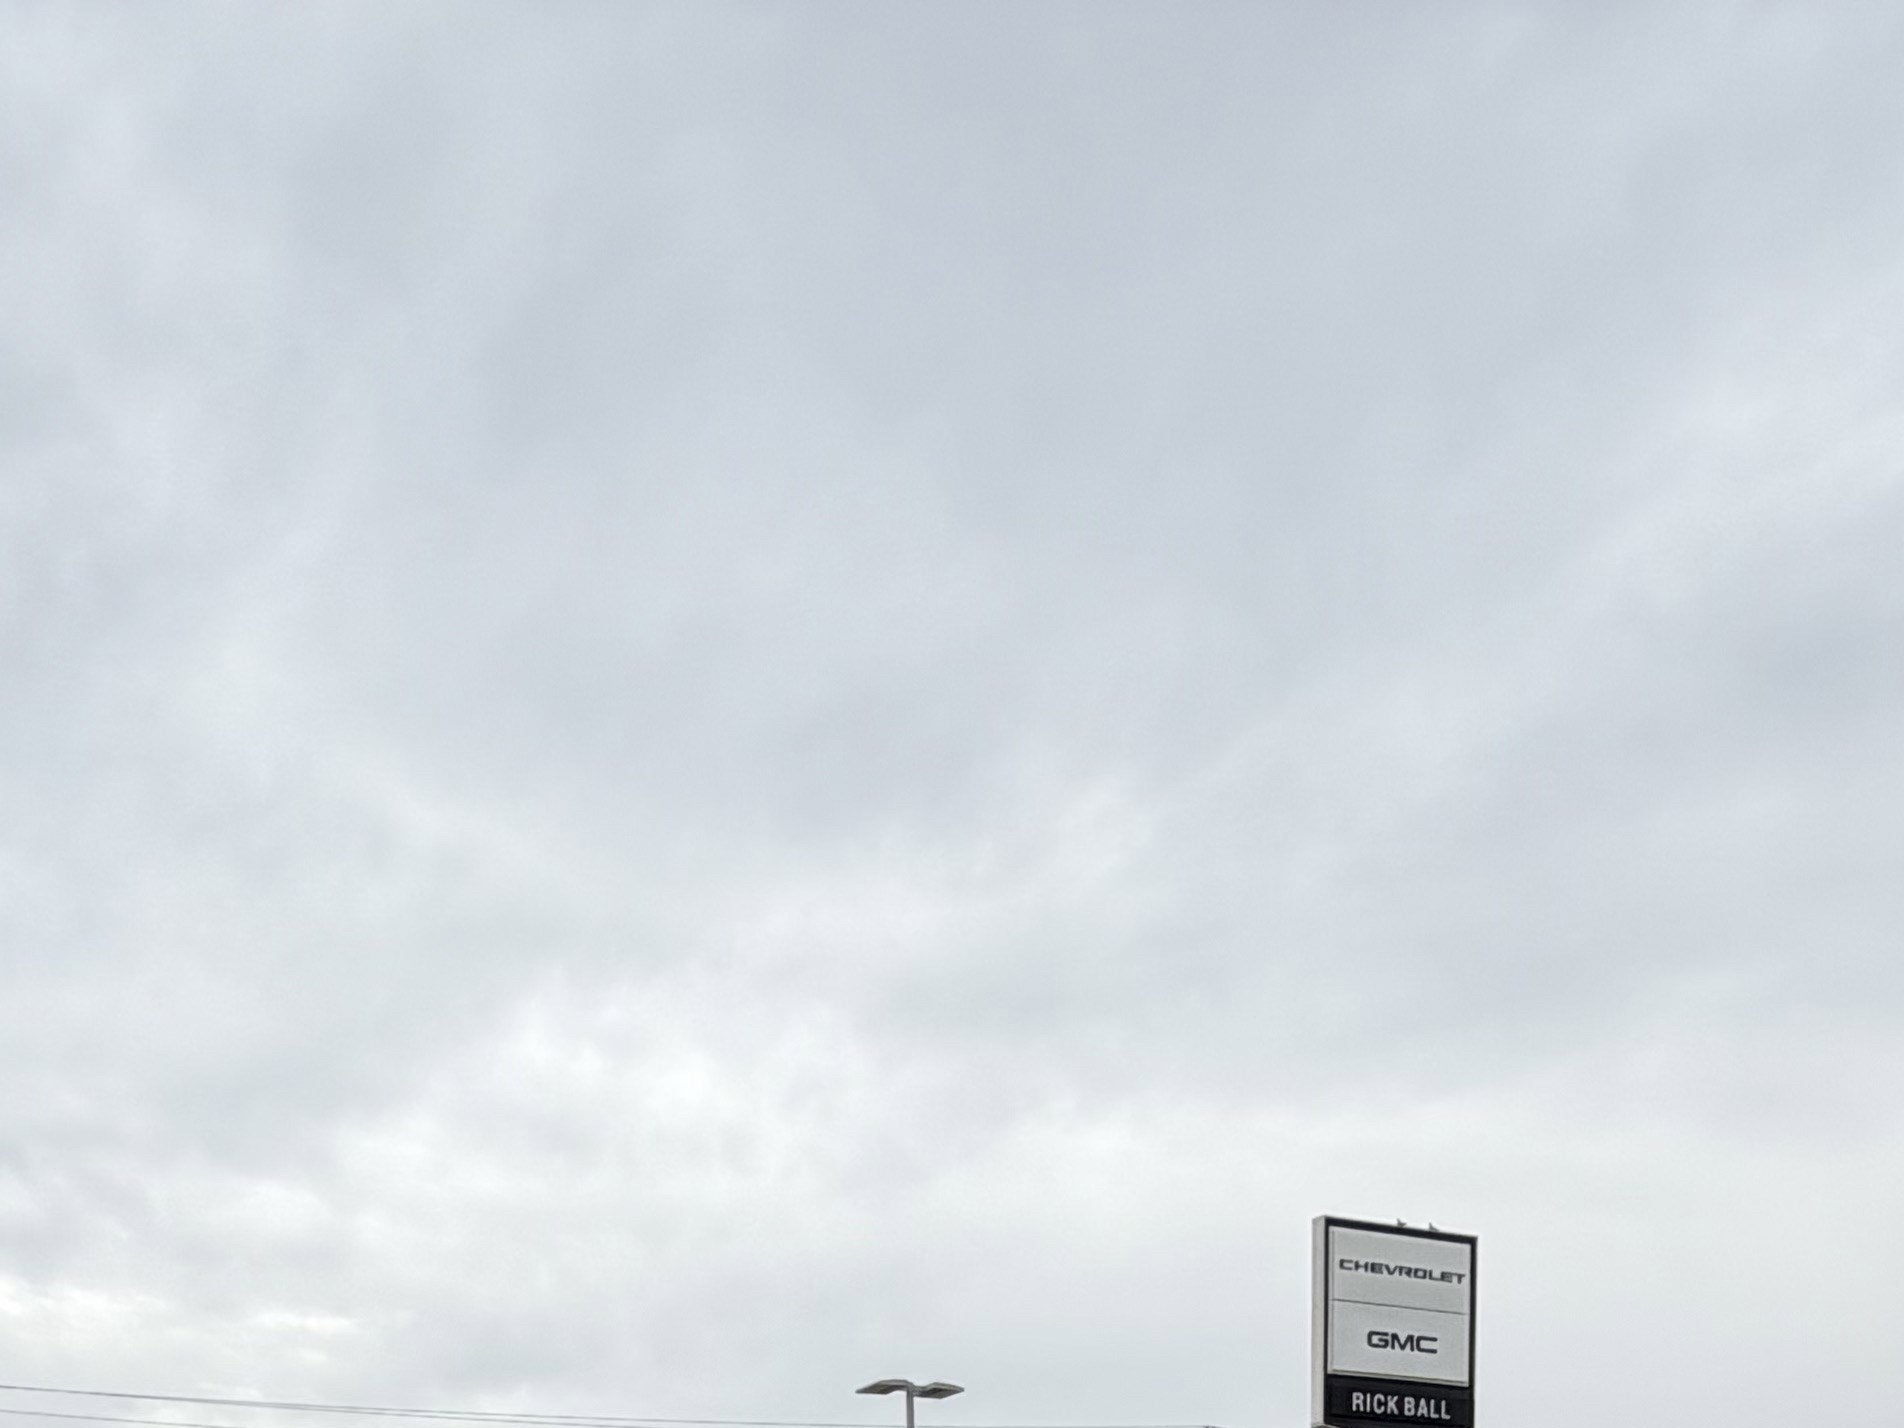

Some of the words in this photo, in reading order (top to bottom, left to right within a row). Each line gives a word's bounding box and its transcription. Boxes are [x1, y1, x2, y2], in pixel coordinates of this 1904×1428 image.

[1339, 1259, 1466, 1285] CHEVROLET
[1367, 1330, 1438, 1354] GMC
[1352, 1391, 1399, 1415] RICK
[1404, 1397, 1451, 1420] BALL
